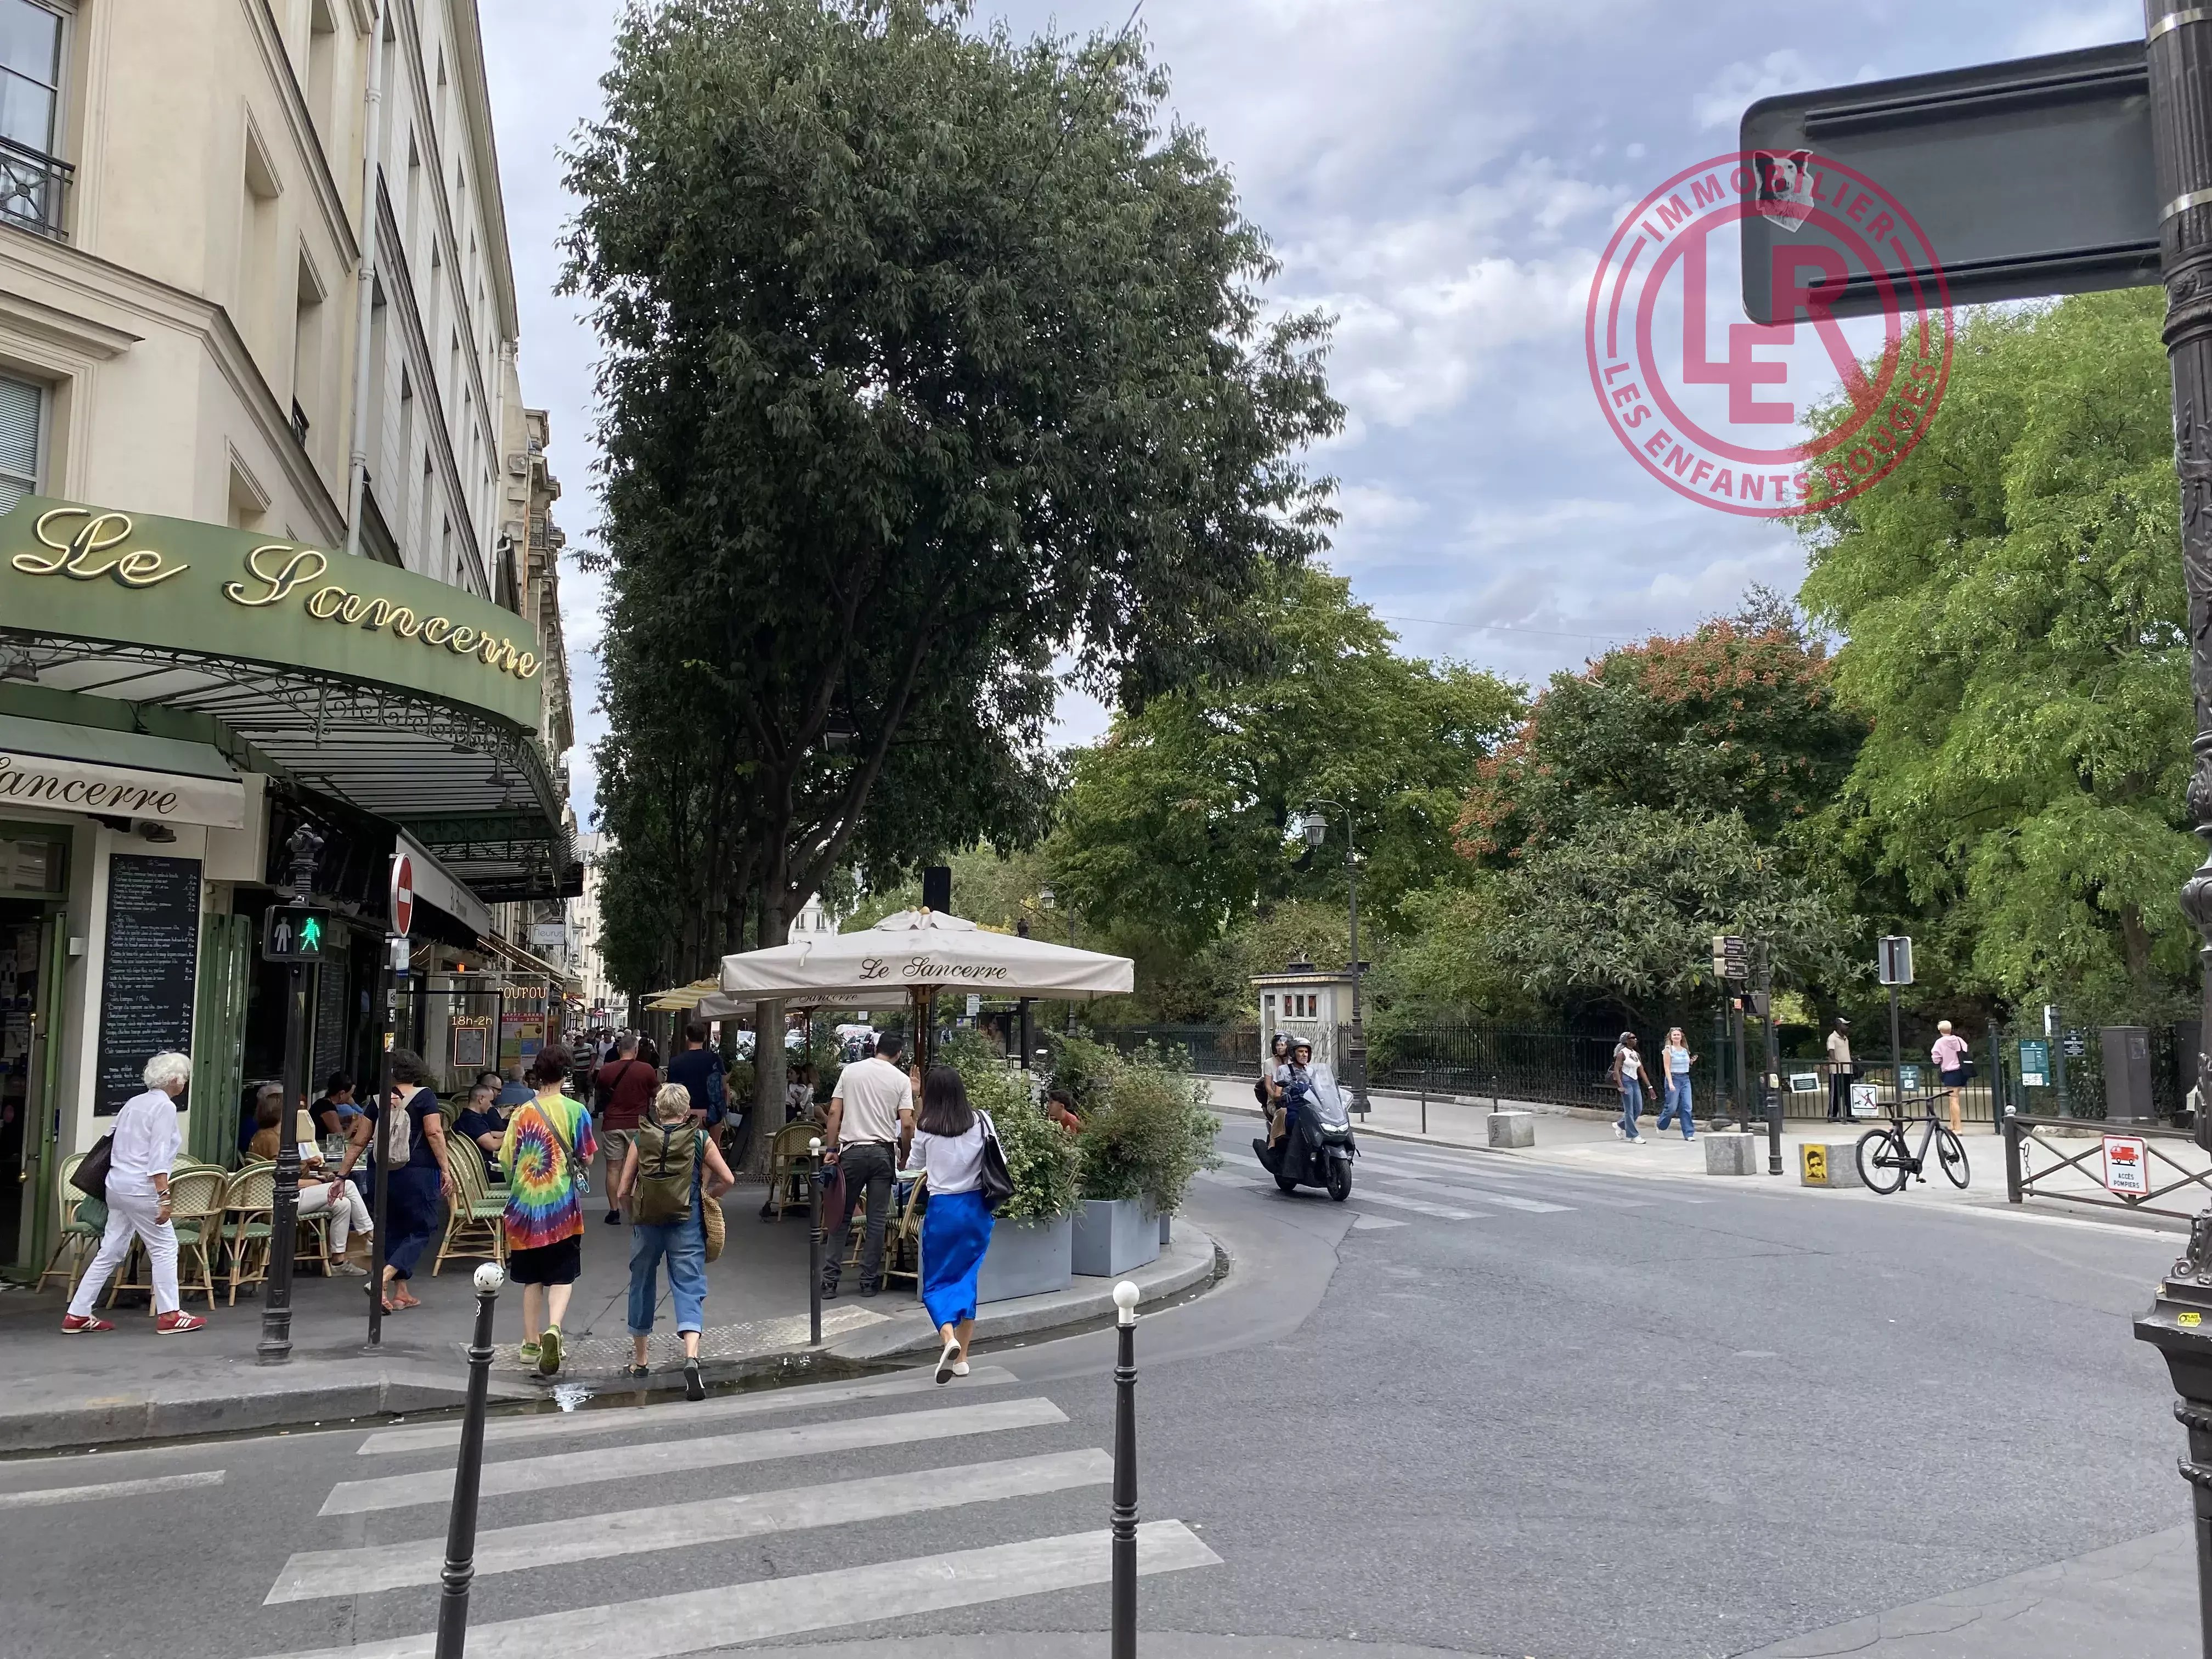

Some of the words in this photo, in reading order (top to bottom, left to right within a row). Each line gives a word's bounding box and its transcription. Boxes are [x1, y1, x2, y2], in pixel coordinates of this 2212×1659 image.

[11, 507, 190, 588] Le
[222, 545, 541, 679] Sancerre
[859, 958, 890, 979] Le
[902, 957, 1007, 979] Sancerre
[452, 1016, 492, 1025] 18h-2h
[2114, 1180, 2140, 1188] POMPIERS
